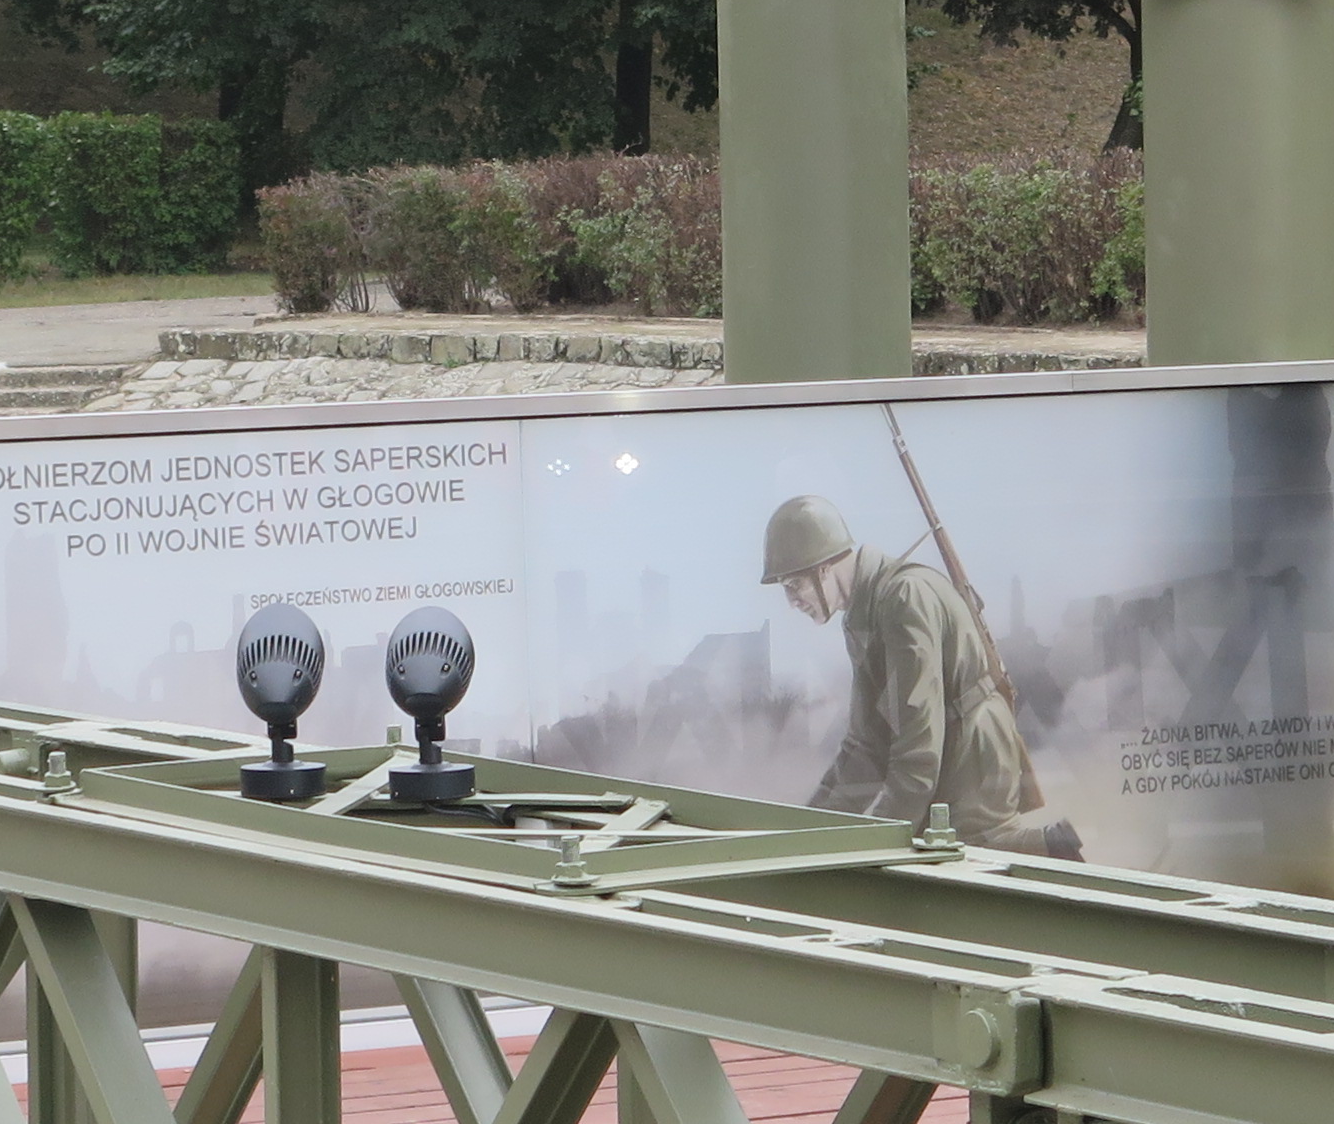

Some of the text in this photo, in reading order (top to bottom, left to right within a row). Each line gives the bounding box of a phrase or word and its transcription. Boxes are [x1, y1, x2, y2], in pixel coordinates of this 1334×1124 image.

[161, 450, 326, 482] JEDNOSTEK
[333, 441, 508, 475] SAPERSKICH
[13, 479, 465, 526] STACJONUJĄCYCH W GŁOGOWIE
[66, 516, 418, 558] PO II WOJNIE ŚWIATOWEJ
[375, 584, 411, 602] ZIEMI
[414, 578, 514, 599] GŁOGOWSKIEJ
[1142, 726, 1190, 746] ŻADNA
[1194, 723, 1244, 742] BITWA,
[1248, 722, 1259, 737] A
[1261, 716, 1312, 736] ZAWDY
[1316, 717, 1321, 731] I
[1121, 750, 1163, 771] OBYĆ
[1166, 749, 1190, 769] SIĘ
[1194, 747, 1223, 766] BEZ
[1226, 740, 1300, 763] SAPERÓW
[1303, 741, 1328, 756] NIE
[1122, 779, 1132, 795] A
[1136, 778, 1167, 794] GDY
[1171, 771, 1221, 792] POKÓJ
[1224, 767, 1295, 787] NASTANIE
[1299, 764, 1325, 780] ONI
